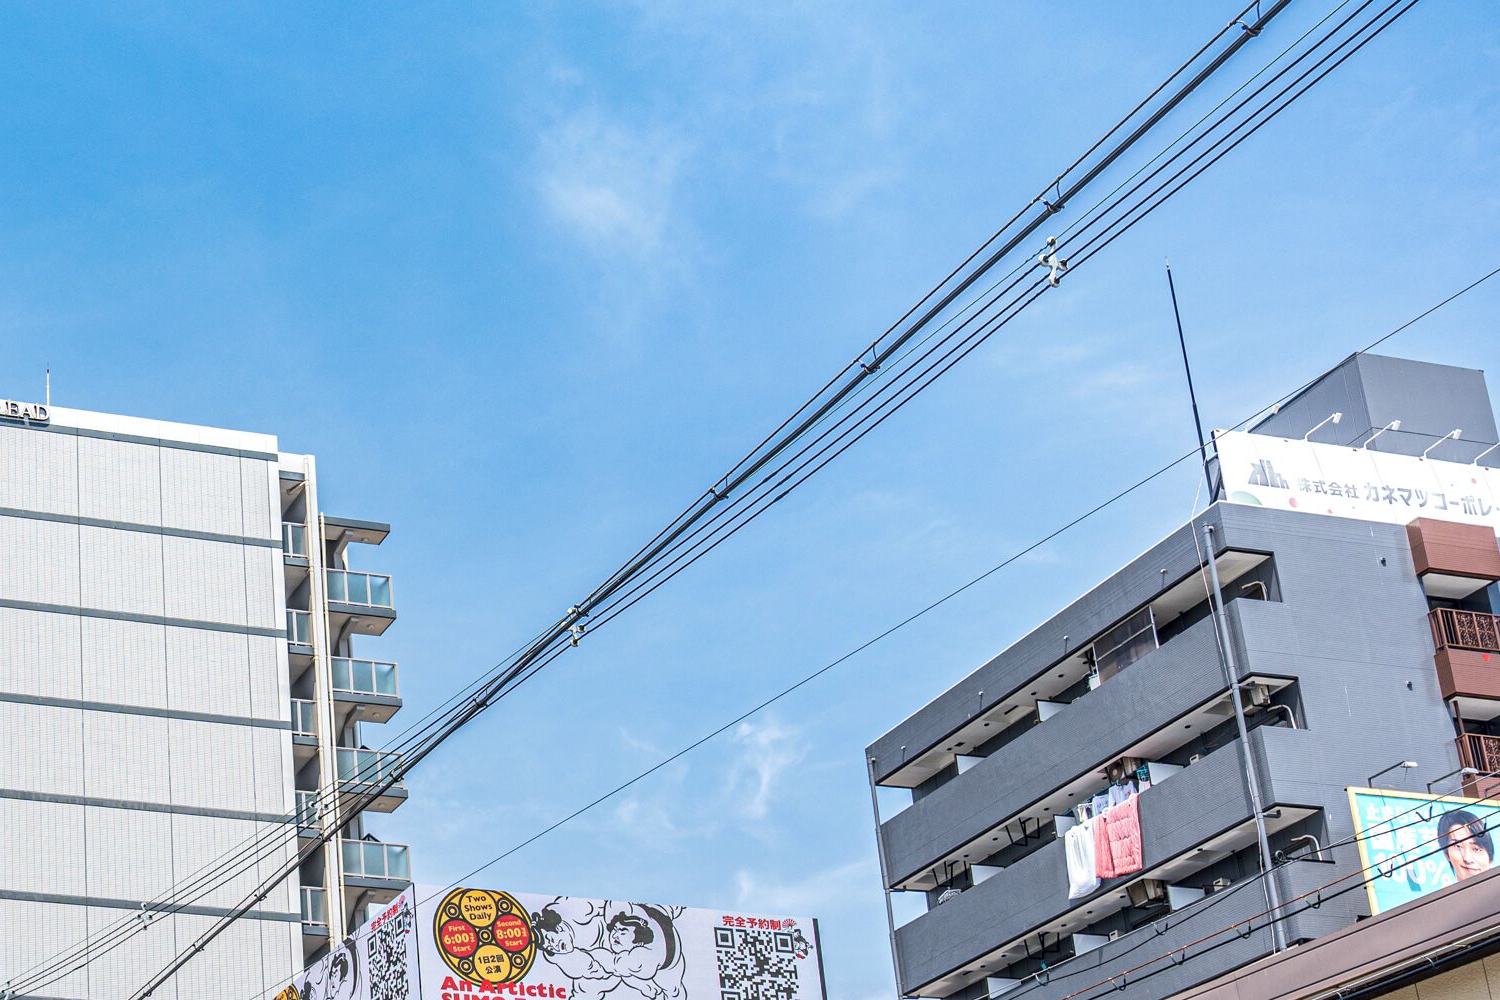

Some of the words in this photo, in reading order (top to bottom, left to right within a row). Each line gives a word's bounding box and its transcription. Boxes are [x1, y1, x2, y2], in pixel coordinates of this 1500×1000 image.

[1297, 477, 1359, 499] 株式会社
[1364, 482, 1500, 516] カネマツコーポレ
[464, 903, 493, 912] Shows
[469, 912, 492, 921] Daily
[496, 919, 521, 928] Second
[722, 916, 781, 930] 完全予約制
[444, 932, 469, 944] 6:00
[496, 928, 521, 940] 8:00
[505, 939, 523, 947] Start
[452, 945, 471, 953] Start
[478, 954, 504, 964] 1日2回
[485, 966, 502, 974] 公演
[441, 976, 472, 992] An
[479, 979, 567, 999] Artictic
